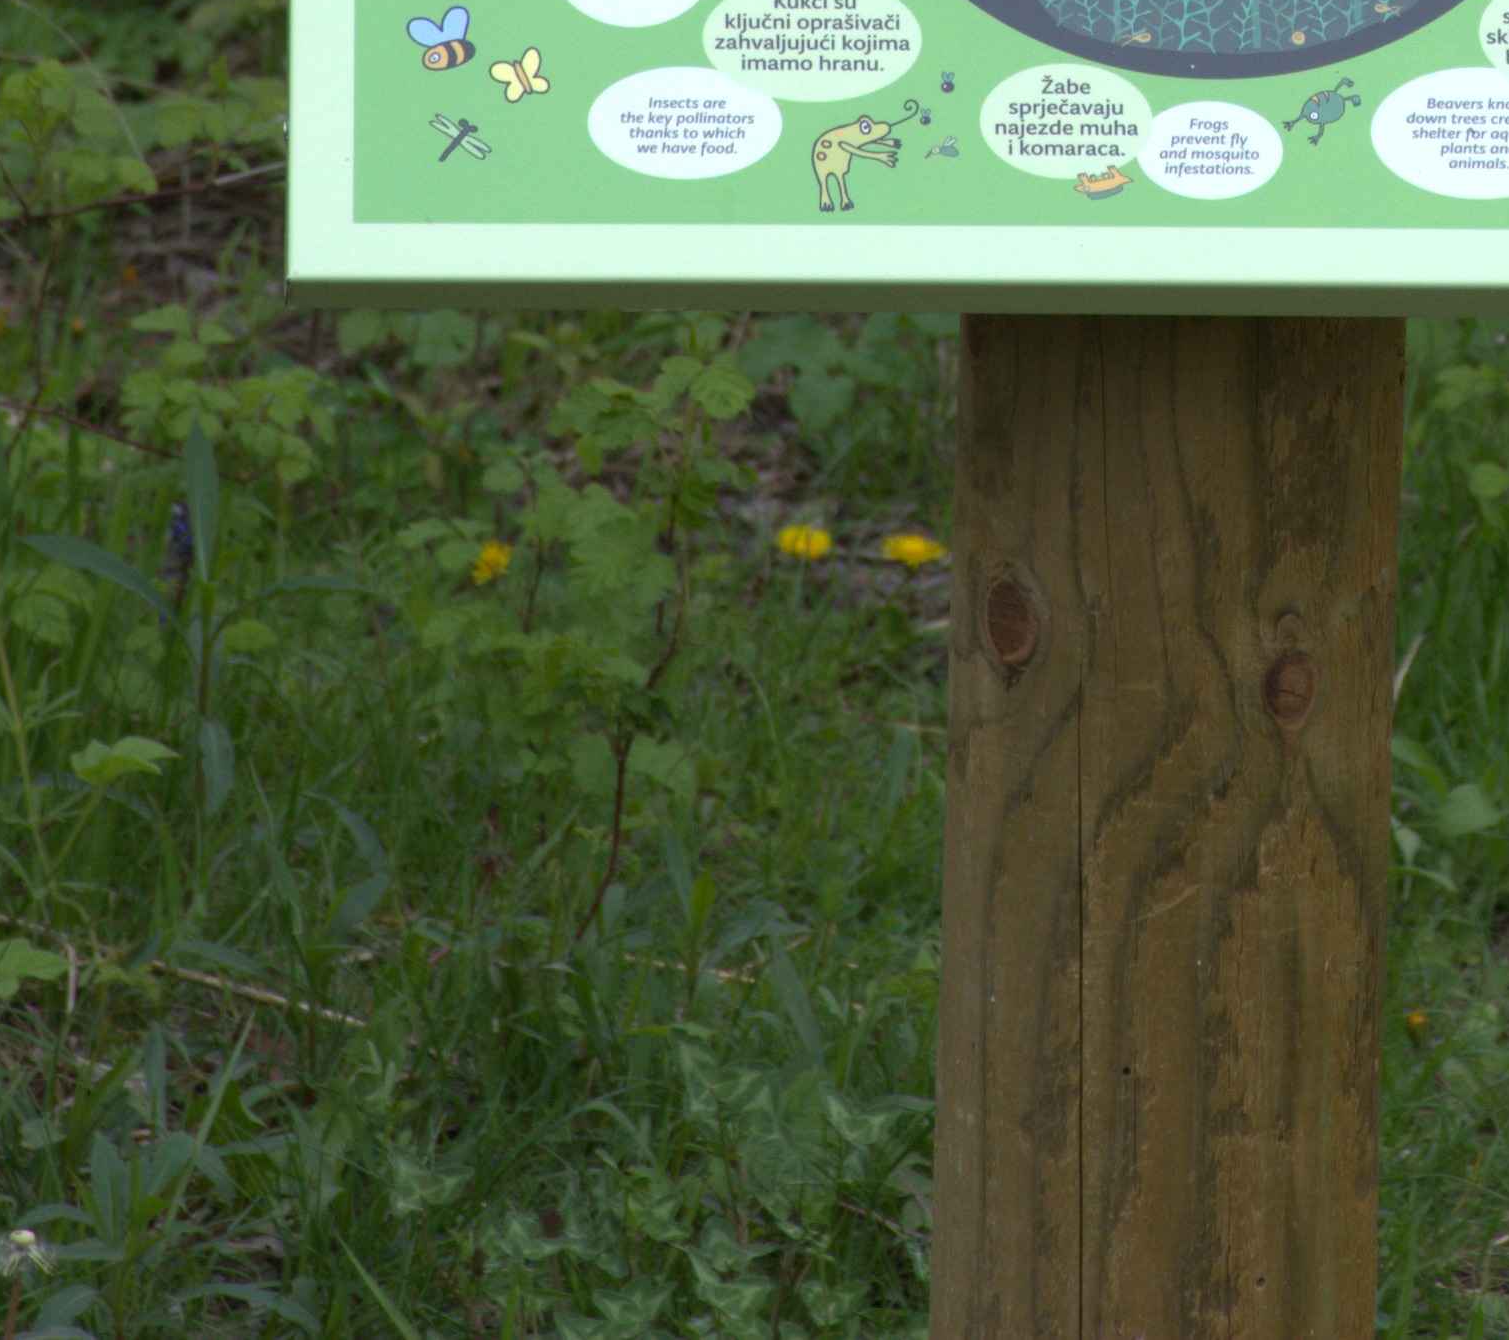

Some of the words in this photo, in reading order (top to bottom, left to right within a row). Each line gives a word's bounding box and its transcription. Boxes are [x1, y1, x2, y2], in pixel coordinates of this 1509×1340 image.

[725, 13, 791, 34] ključni
[797, 13, 900, 35] oprašivači
[715, 33, 835, 55] zahvaljujući
[842, 34, 911, 56] kojima
[741, 54, 813, 71] imamo
[819, 54, 884, 72] hranu.
[1041, 74, 1091, 95] Žabe
[1009, 98, 1124, 120] sprječavaju
[995, 118, 1074, 140] najezde
[1080, 118, 1139, 136] muha
[1008, 139, 1013, 156] i
[1018, 139, 1126, 157] komaraca.
